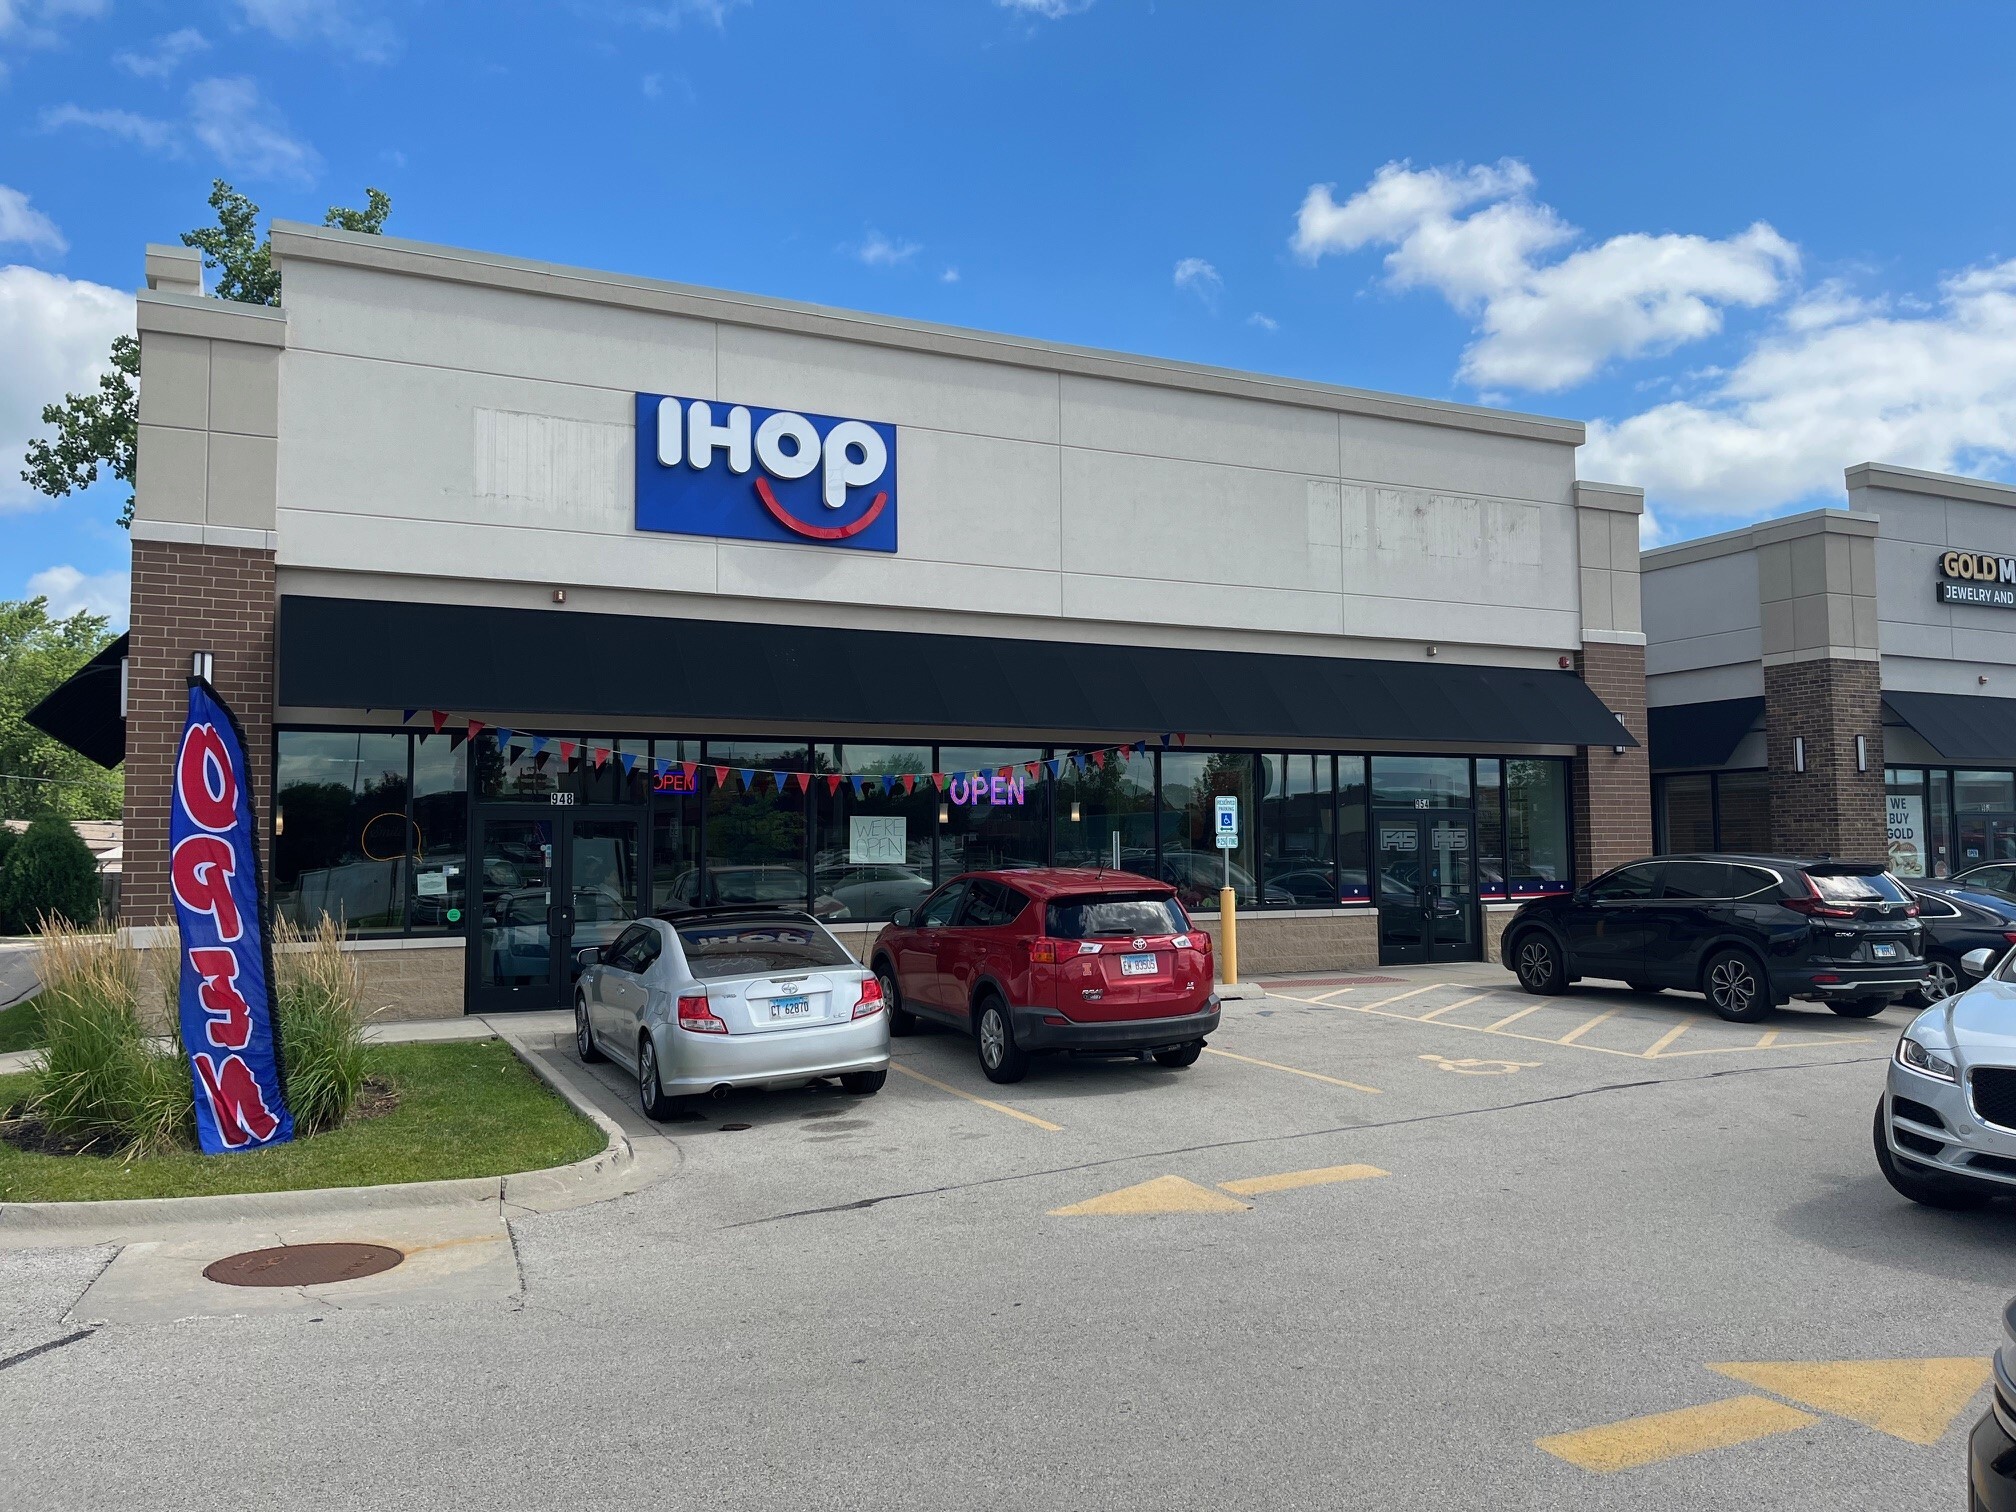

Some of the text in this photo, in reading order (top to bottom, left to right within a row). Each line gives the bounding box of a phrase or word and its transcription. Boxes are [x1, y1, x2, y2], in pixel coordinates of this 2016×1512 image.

[657, 397, 887, 508] IHOP
[1943, 552, 1997, 581] GOLD
[1946, 585, 2014, 604] JEWELRY AND
[653, 774, 695, 791] OPEN
[949, 776, 1025, 806] OPEN
[551, 793, 573, 805] 948
[1415, 799, 1430, 809] 954
[1890, 798, 1907, 810] WE
[1889, 812, 1910, 825] BUY
[1381, 829, 1418, 850] F45
[1432, 829, 1468, 850] F45
[1887, 828, 1914, 839] GOLD
[856, 837, 903, 860] OPEN
[771, 1001, 809, 1017] CT 62870
